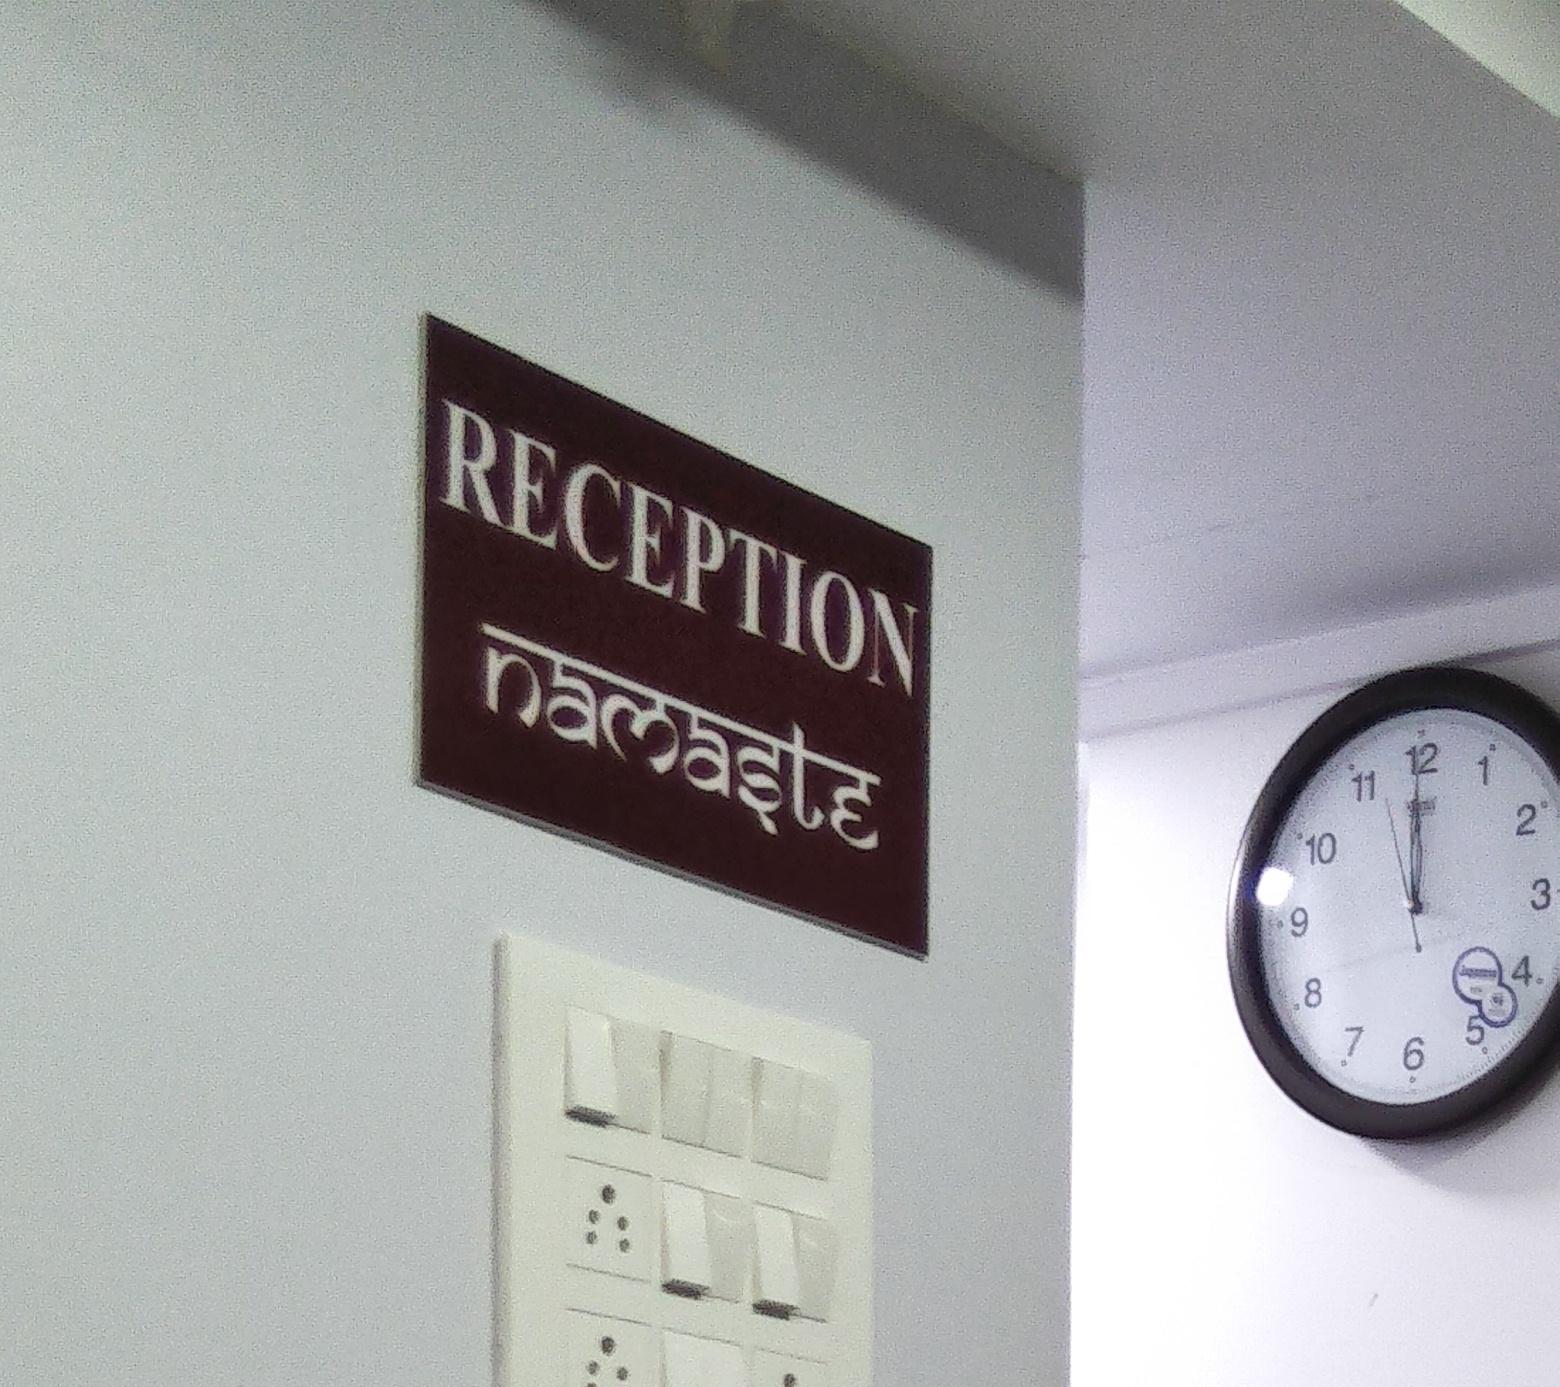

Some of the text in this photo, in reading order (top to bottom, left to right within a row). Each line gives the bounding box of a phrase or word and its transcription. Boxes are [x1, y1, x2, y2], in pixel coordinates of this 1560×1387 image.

[440, 397, 920, 698] RECEPTION
[481, 623, 882, 850] namaste
[1405, 742, 1439, 774] 12
[1477, 756, 1490, 786] 1
[1352, 771, 1376, 801] 11
[1516, 803, 1537, 836] 2
[1304, 832, 1337, 866] 10
[1530, 878, 1552, 910] 3
[1290, 907, 1309, 938] 9
[1511, 955, 1533, 987] 4
[1304, 978, 1322, 1008] 8
[1344, 1026, 1364, 1057] 7
[1465, 1015, 1485, 1045] 5
[1402, 1037, 1424, 1070] 6
